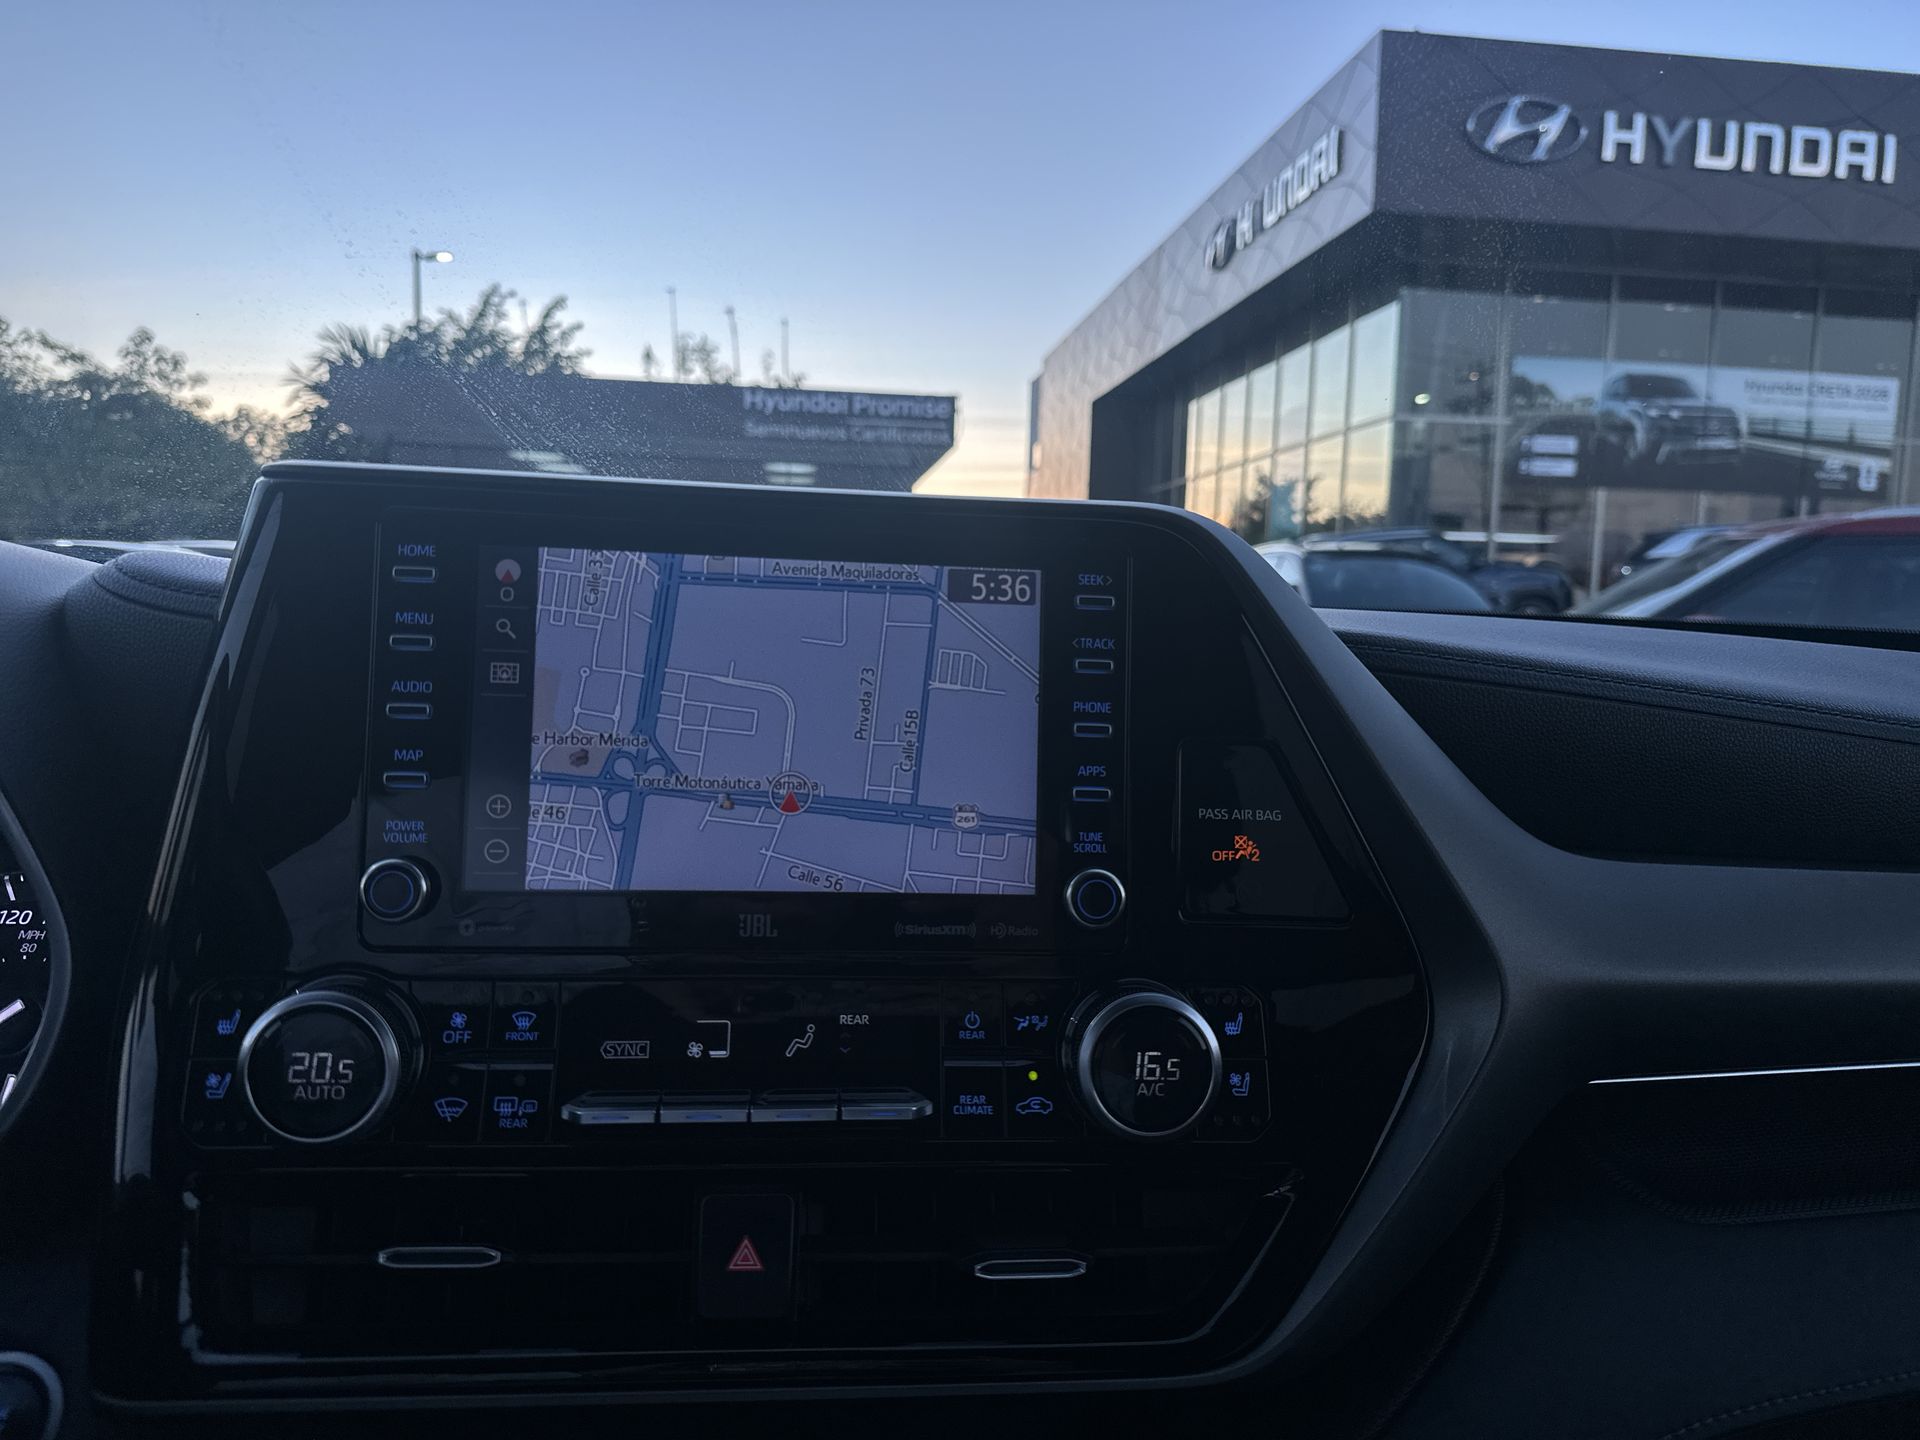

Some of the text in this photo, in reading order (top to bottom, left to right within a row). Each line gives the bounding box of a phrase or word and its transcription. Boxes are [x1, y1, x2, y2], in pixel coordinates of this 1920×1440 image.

[1601, 109, 1898, 184] HYUNDAI
[743, 389, 951, 418] Hyundai Promise
[398, 544, 436, 558] HOME
[771, 561, 920, 581] Avenida Maquiladoras
[584, 572, 601, 606] Calle
[971, 573, 1031, 602] 5:36
[395, 611, 434, 625] MENU
[391, 680, 433, 693] AUDIO
[854, 667, 875, 741] Privada 73
[1072, 701, 1113, 714] PHONE
[543, 731, 594, 746] Harbor
[600, 733, 649, 747] Mérida
[394, 749, 424, 761] MAP
[900, 740, 916, 772] Calle
[1077, 766, 1107, 778] APPS
[634, 773, 670, 788] Torre
[675, 775, 762, 790] Motonáutica
[544, 805, 566, 820] 46
[1198, 808, 1282, 821] PASS AIR BAG
[385, 820, 425, 832] POWER
[383, 832, 430, 844] VOLUME
[1078, 832, 1104, 843] TUNE
[1073, 843, 1107, 854] SCROLL
[1211, 848, 1260, 862] OFF 2
[788, 865, 844, 891] Calle 56
[0, 909, 33, 925] 120
[739, 913, 778, 937] JBL
[1008, 925, 1039, 937] Radio
[17, 929, 47, 941] MPH
[20, 943, 38, 953] 80
[839, 1014, 870, 1025] REAR
[442, 1030, 473, 1044] OFF
[505, 1031, 540, 1041] FRONT
[959, 1030, 986, 1040] REAR
[605, 1043, 646, 1057] SYNC
[288, 1051, 355, 1084] 20.5
[1135, 1051, 1181, 1080] 16.5
[294, 1084, 346, 1100] AUTO
[1136, 1082, 1166, 1097] A/C
[960, 1094, 987, 1104] REAR
[953, 1104, 993, 1115] CLIMATE
[499, 1118, 529, 1128] REAR
